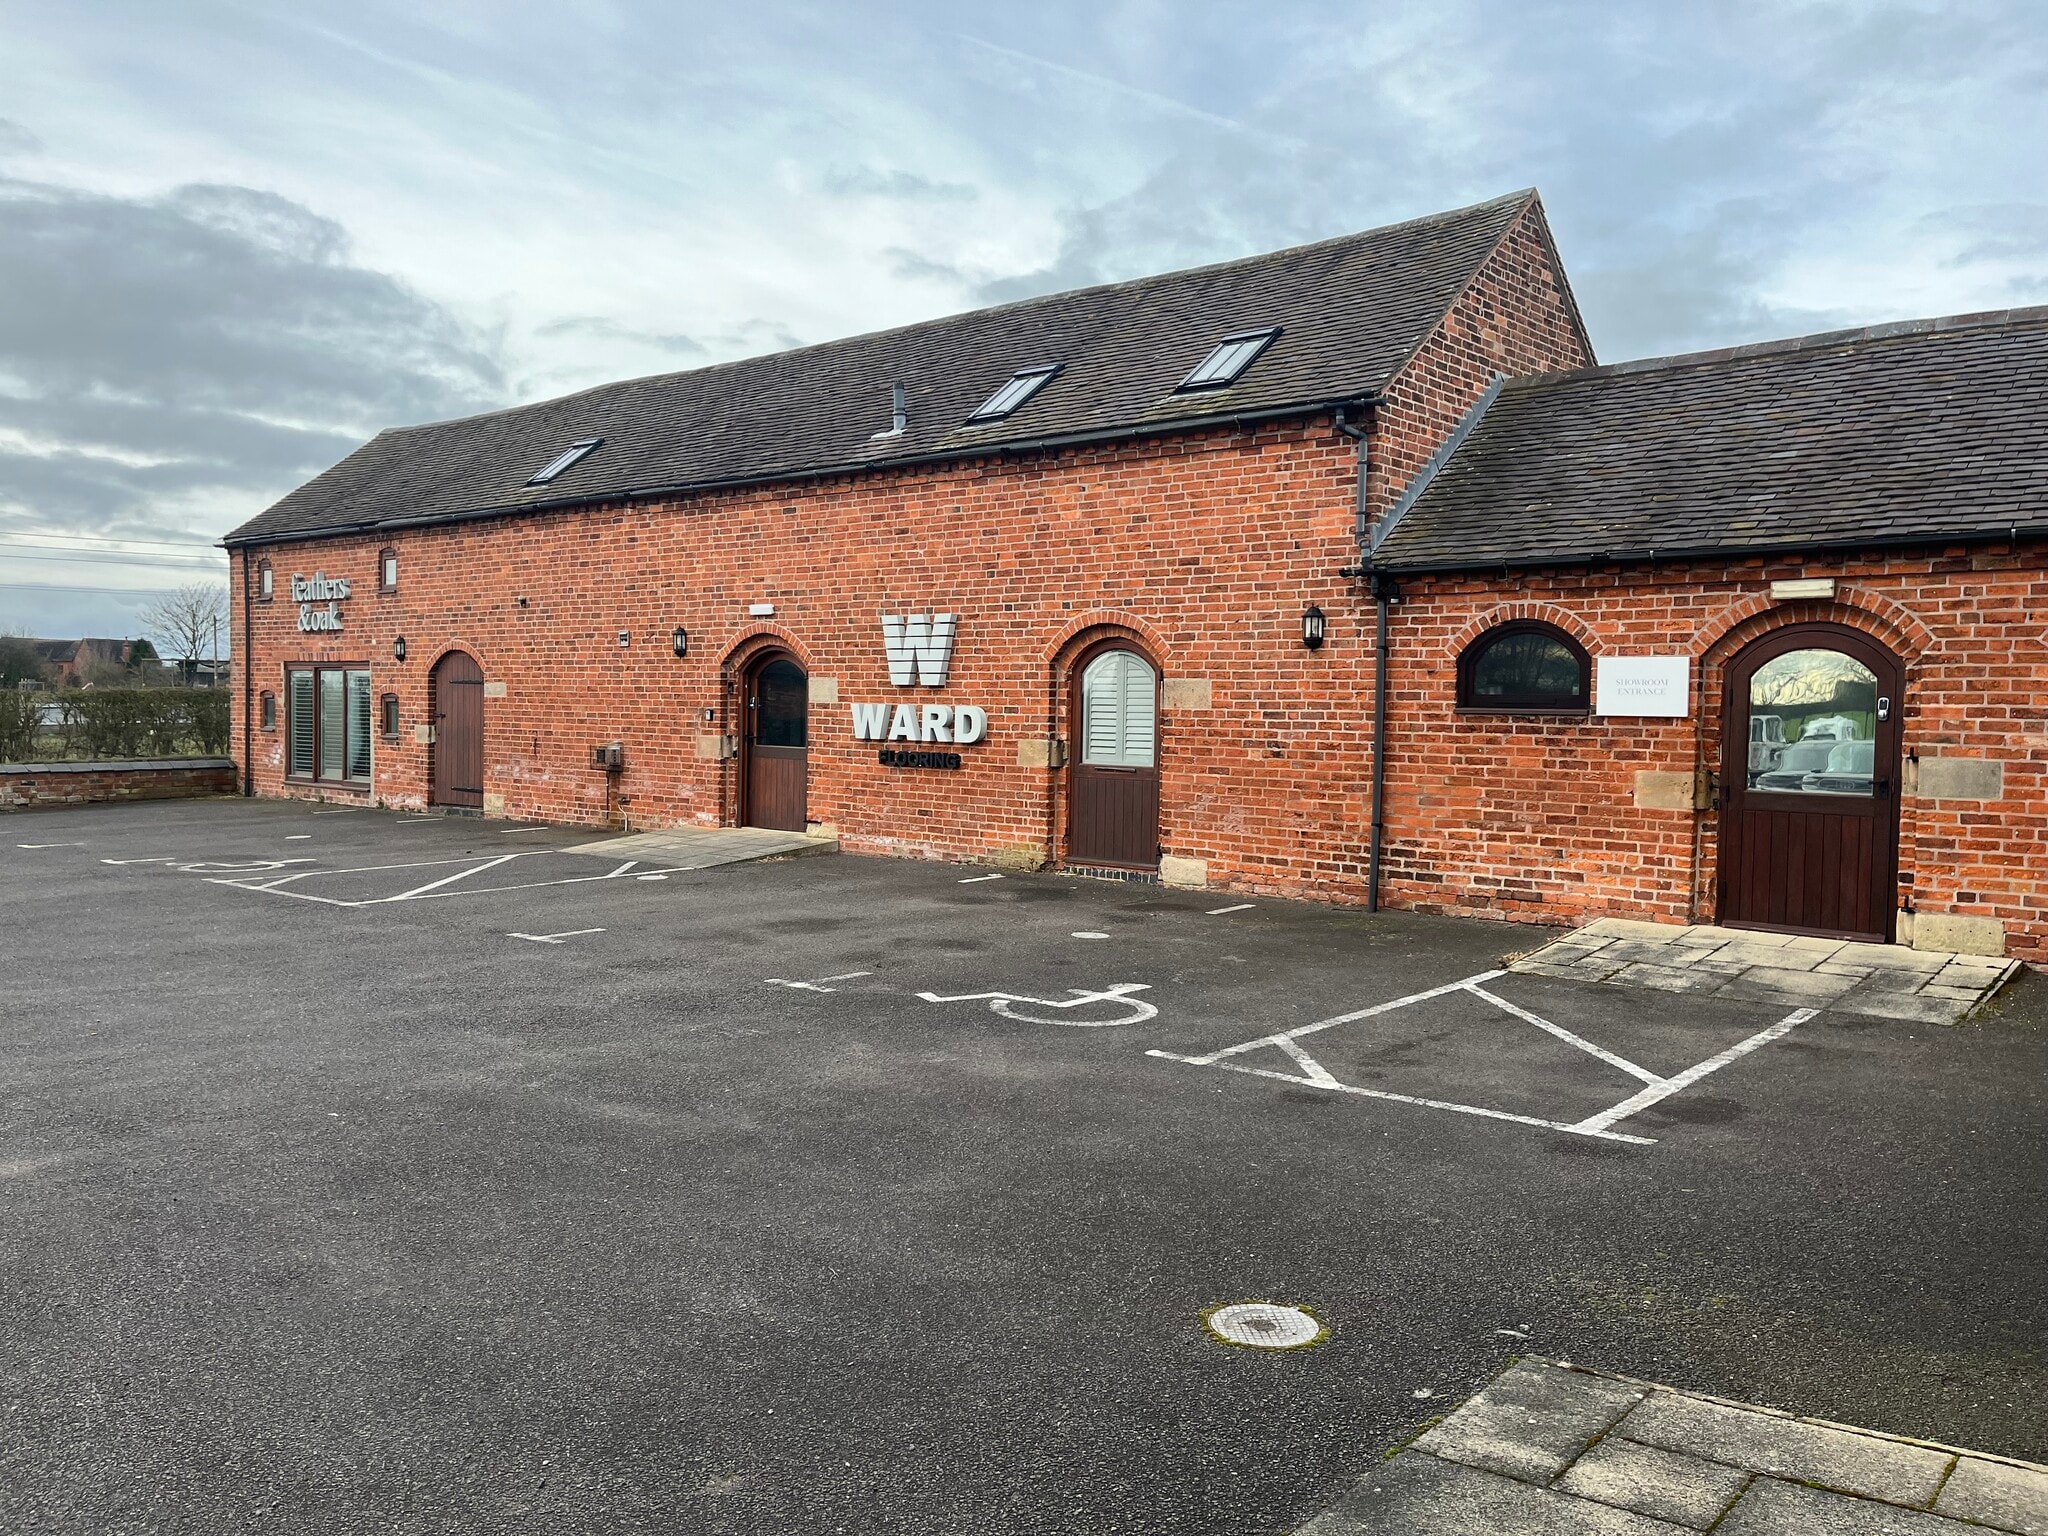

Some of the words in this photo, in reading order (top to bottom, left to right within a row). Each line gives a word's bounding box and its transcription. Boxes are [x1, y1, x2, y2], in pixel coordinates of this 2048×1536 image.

[292, 571, 350, 601] feathers
[881, 613, 958, 687] W
[1616, 679, 1668, 687] SHOWROOM
[851, 703, 987, 744] WARD
[879, 750, 960, 769] FLOORING
